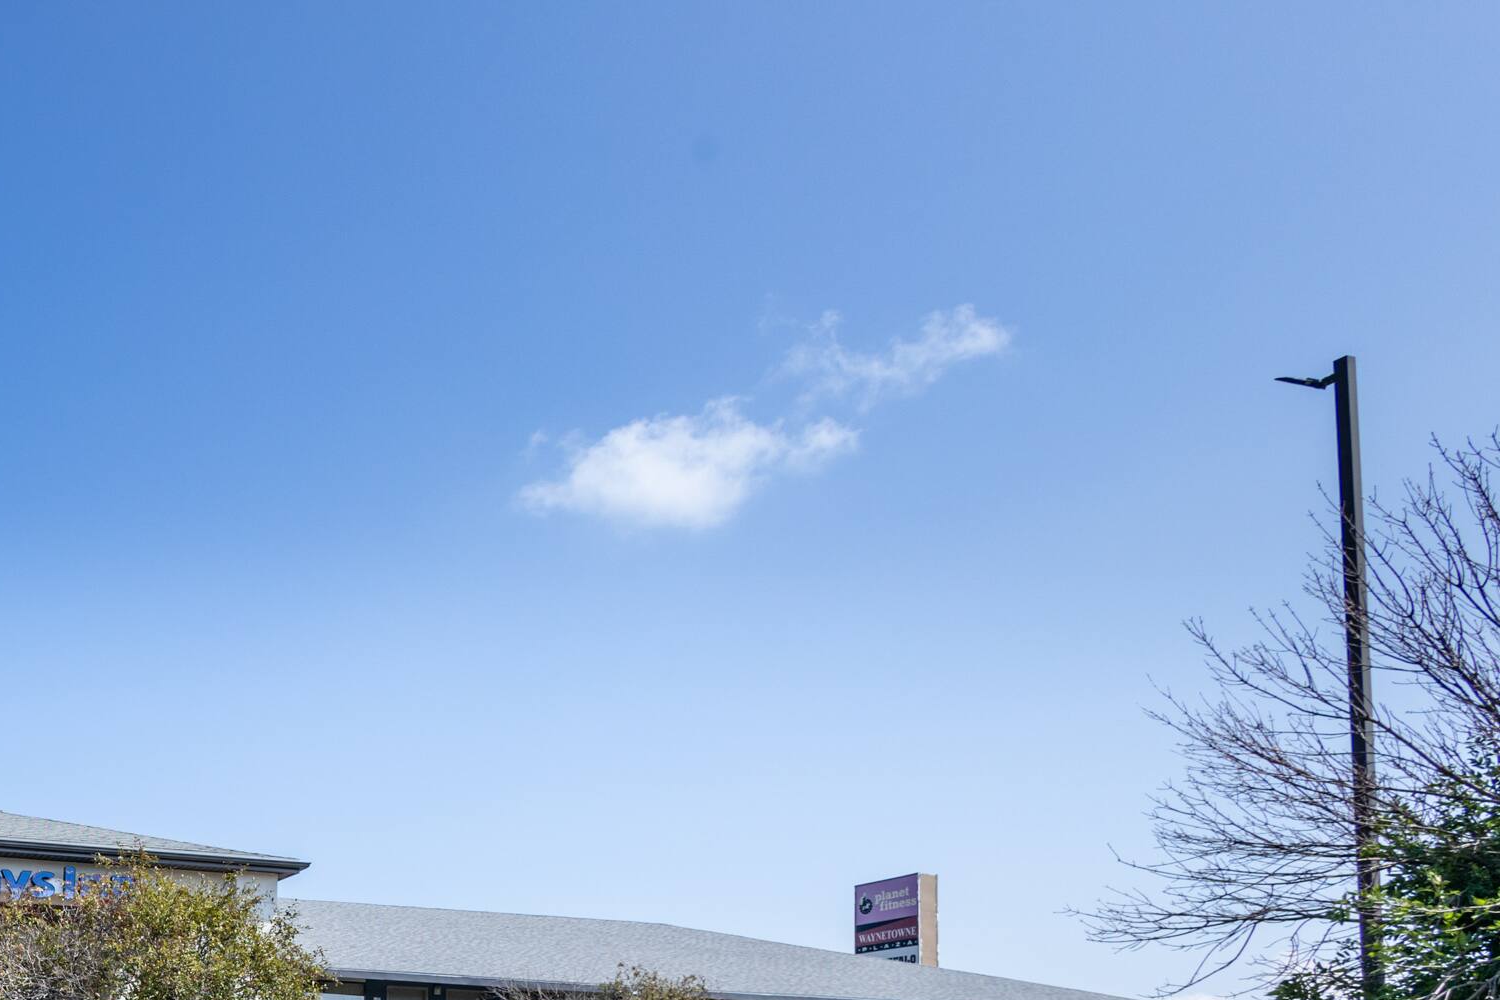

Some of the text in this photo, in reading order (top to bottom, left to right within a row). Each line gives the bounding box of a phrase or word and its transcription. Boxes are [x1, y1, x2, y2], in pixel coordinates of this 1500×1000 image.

[875, 887, 909, 905] planet
[880, 898, 916, 911] fitness
[859, 926, 917, 943] WAYNETOWNE
